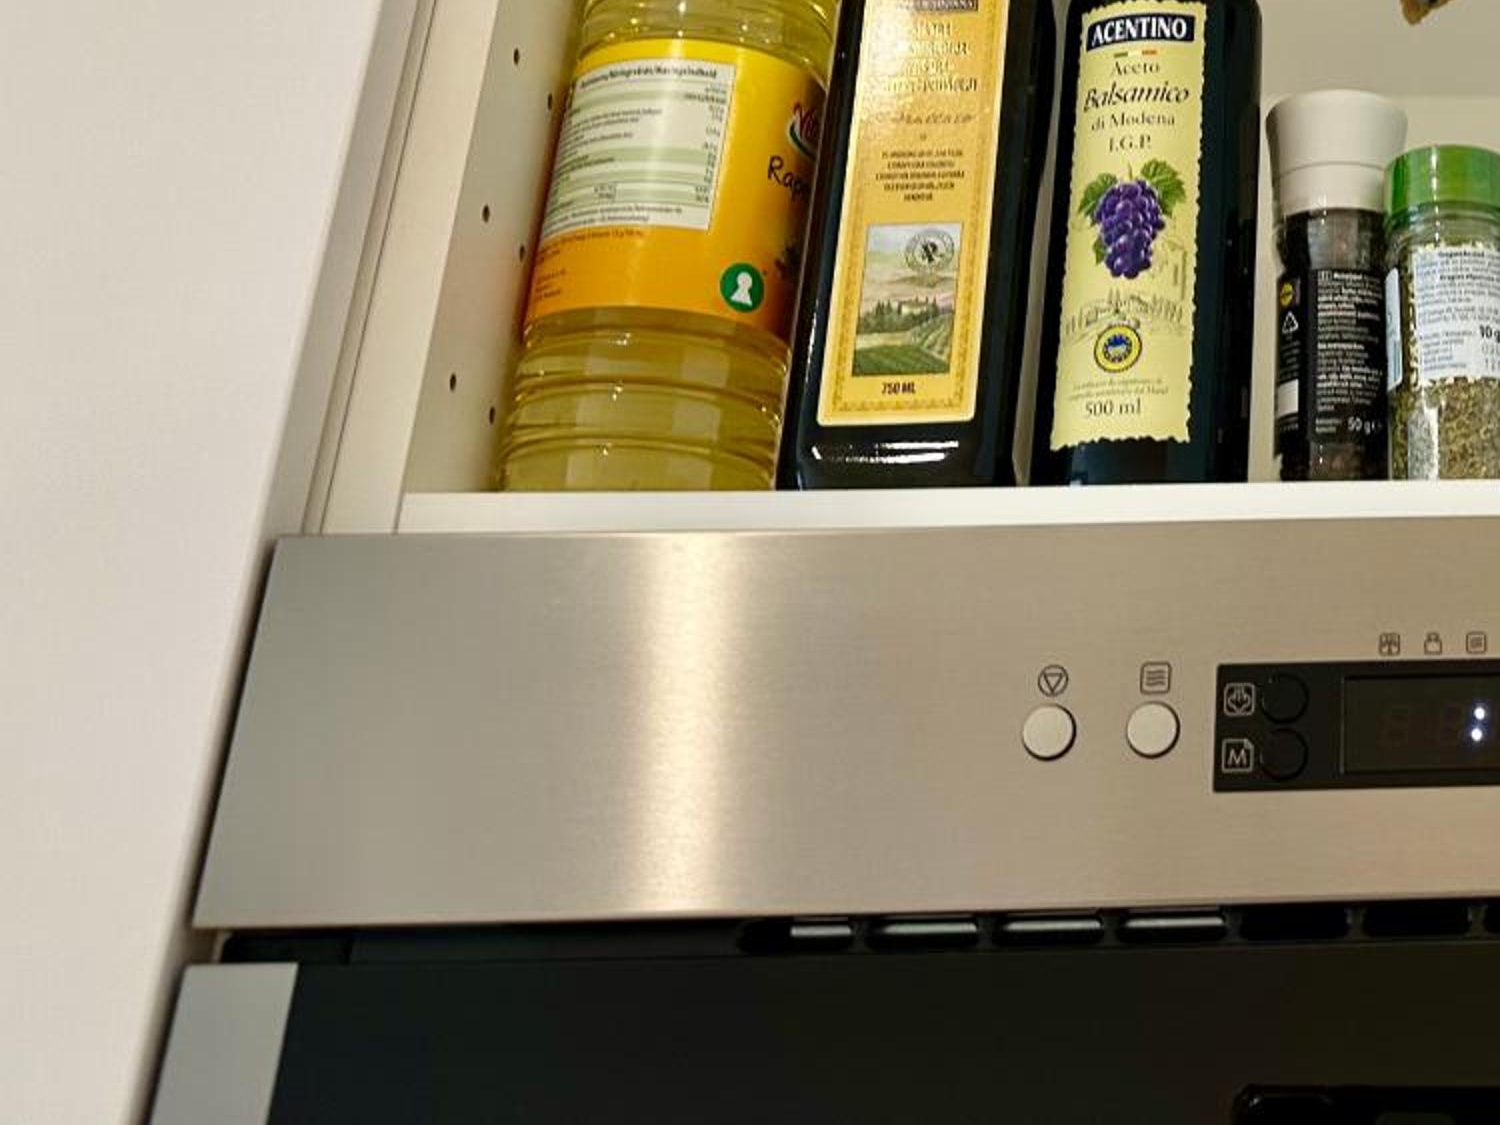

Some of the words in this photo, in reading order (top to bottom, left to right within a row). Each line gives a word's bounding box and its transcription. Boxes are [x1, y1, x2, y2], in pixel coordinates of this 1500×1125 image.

[1091, 15, 1188, 48] ACENTINO
[1110, 61, 1161, 76] Aceto
[1083, 80, 1190, 113] Balsamico
[1091, 115, 1105, 131] di
[1110, 111, 1176, 127] Modena
[1085, 399, 1114, 416] 500
[1119, 397, 1141, 415] ml
